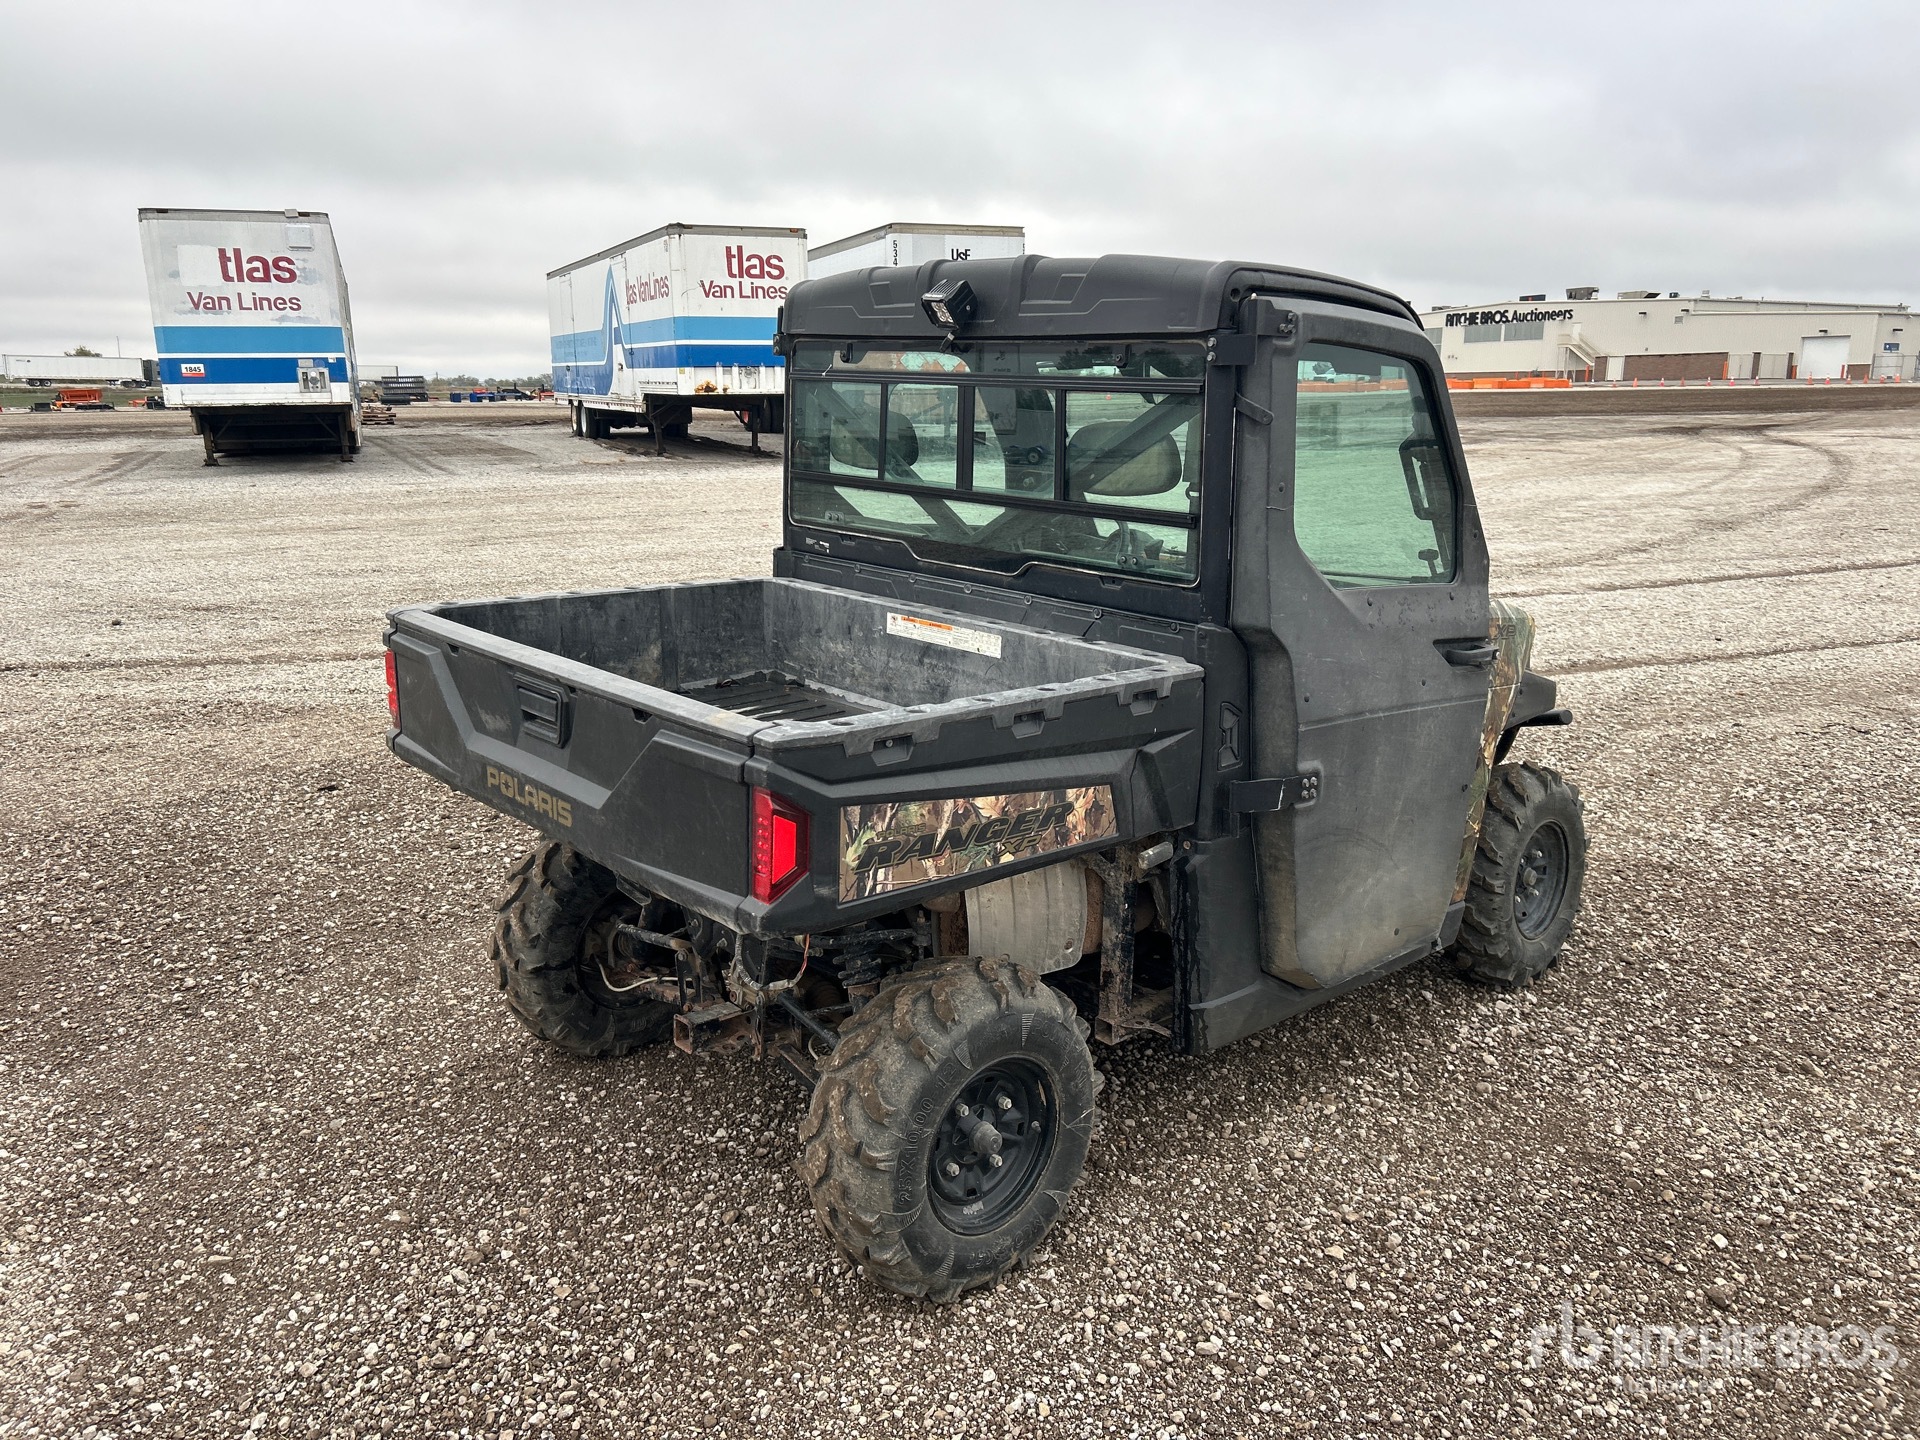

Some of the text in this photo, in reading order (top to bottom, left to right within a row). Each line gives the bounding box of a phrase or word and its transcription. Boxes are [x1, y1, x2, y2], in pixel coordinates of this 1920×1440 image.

[217, 247, 298, 284] tlas
[725, 245, 785, 280] tlas
[636, 275, 649, 303] Van
[648, 271, 670, 301] Lines
[700, 280, 788, 300] Van Lines
[186, 292, 302, 311] Van Lines
[1445, 311, 1480, 327] RITCHIE
[1511, 307, 1574, 323] Auctioneers
[486, 764, 573, 828] POLARIS
[855, 801, 1074, 874] RANGER
[877, 822, 926, 838] POLARIS
[998, 834, 1043, 857] XP
